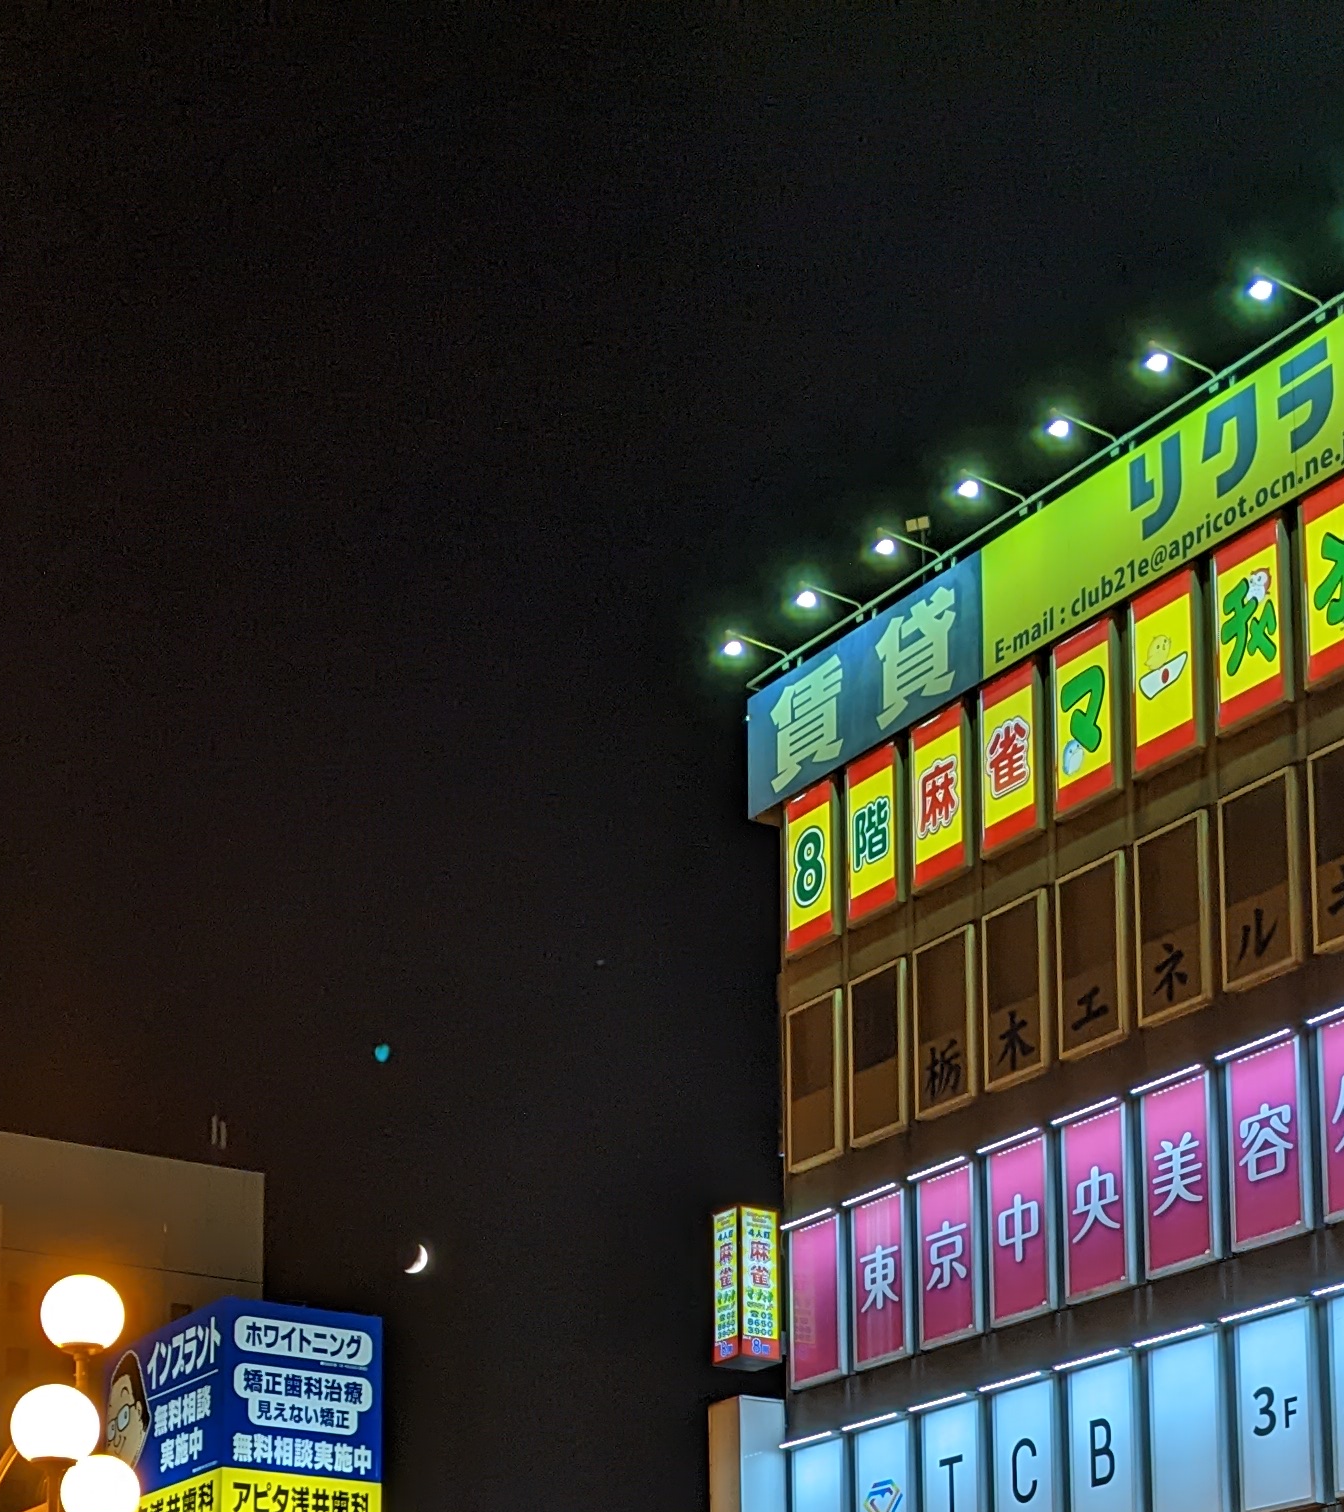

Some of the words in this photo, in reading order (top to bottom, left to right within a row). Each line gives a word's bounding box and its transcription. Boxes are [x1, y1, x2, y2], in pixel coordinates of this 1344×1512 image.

[770, 586, 956, 793] 賃貸
[146, 1316, 222, 1390] インプラント
[244, 1321, 363, 1361] ホワイトニング
[243, 1369, 364, 1406] 矯正歯科治療
[153, 1385, 212, 1438] 無料相談
[257, 1400, 351, 1430] 見えない矯正
[1252, 1385, 1298, 1437] 3F
[159, 1427, 204, 1473] 実施中
[232, 1432, 373, 1476] 無料相談実施中
